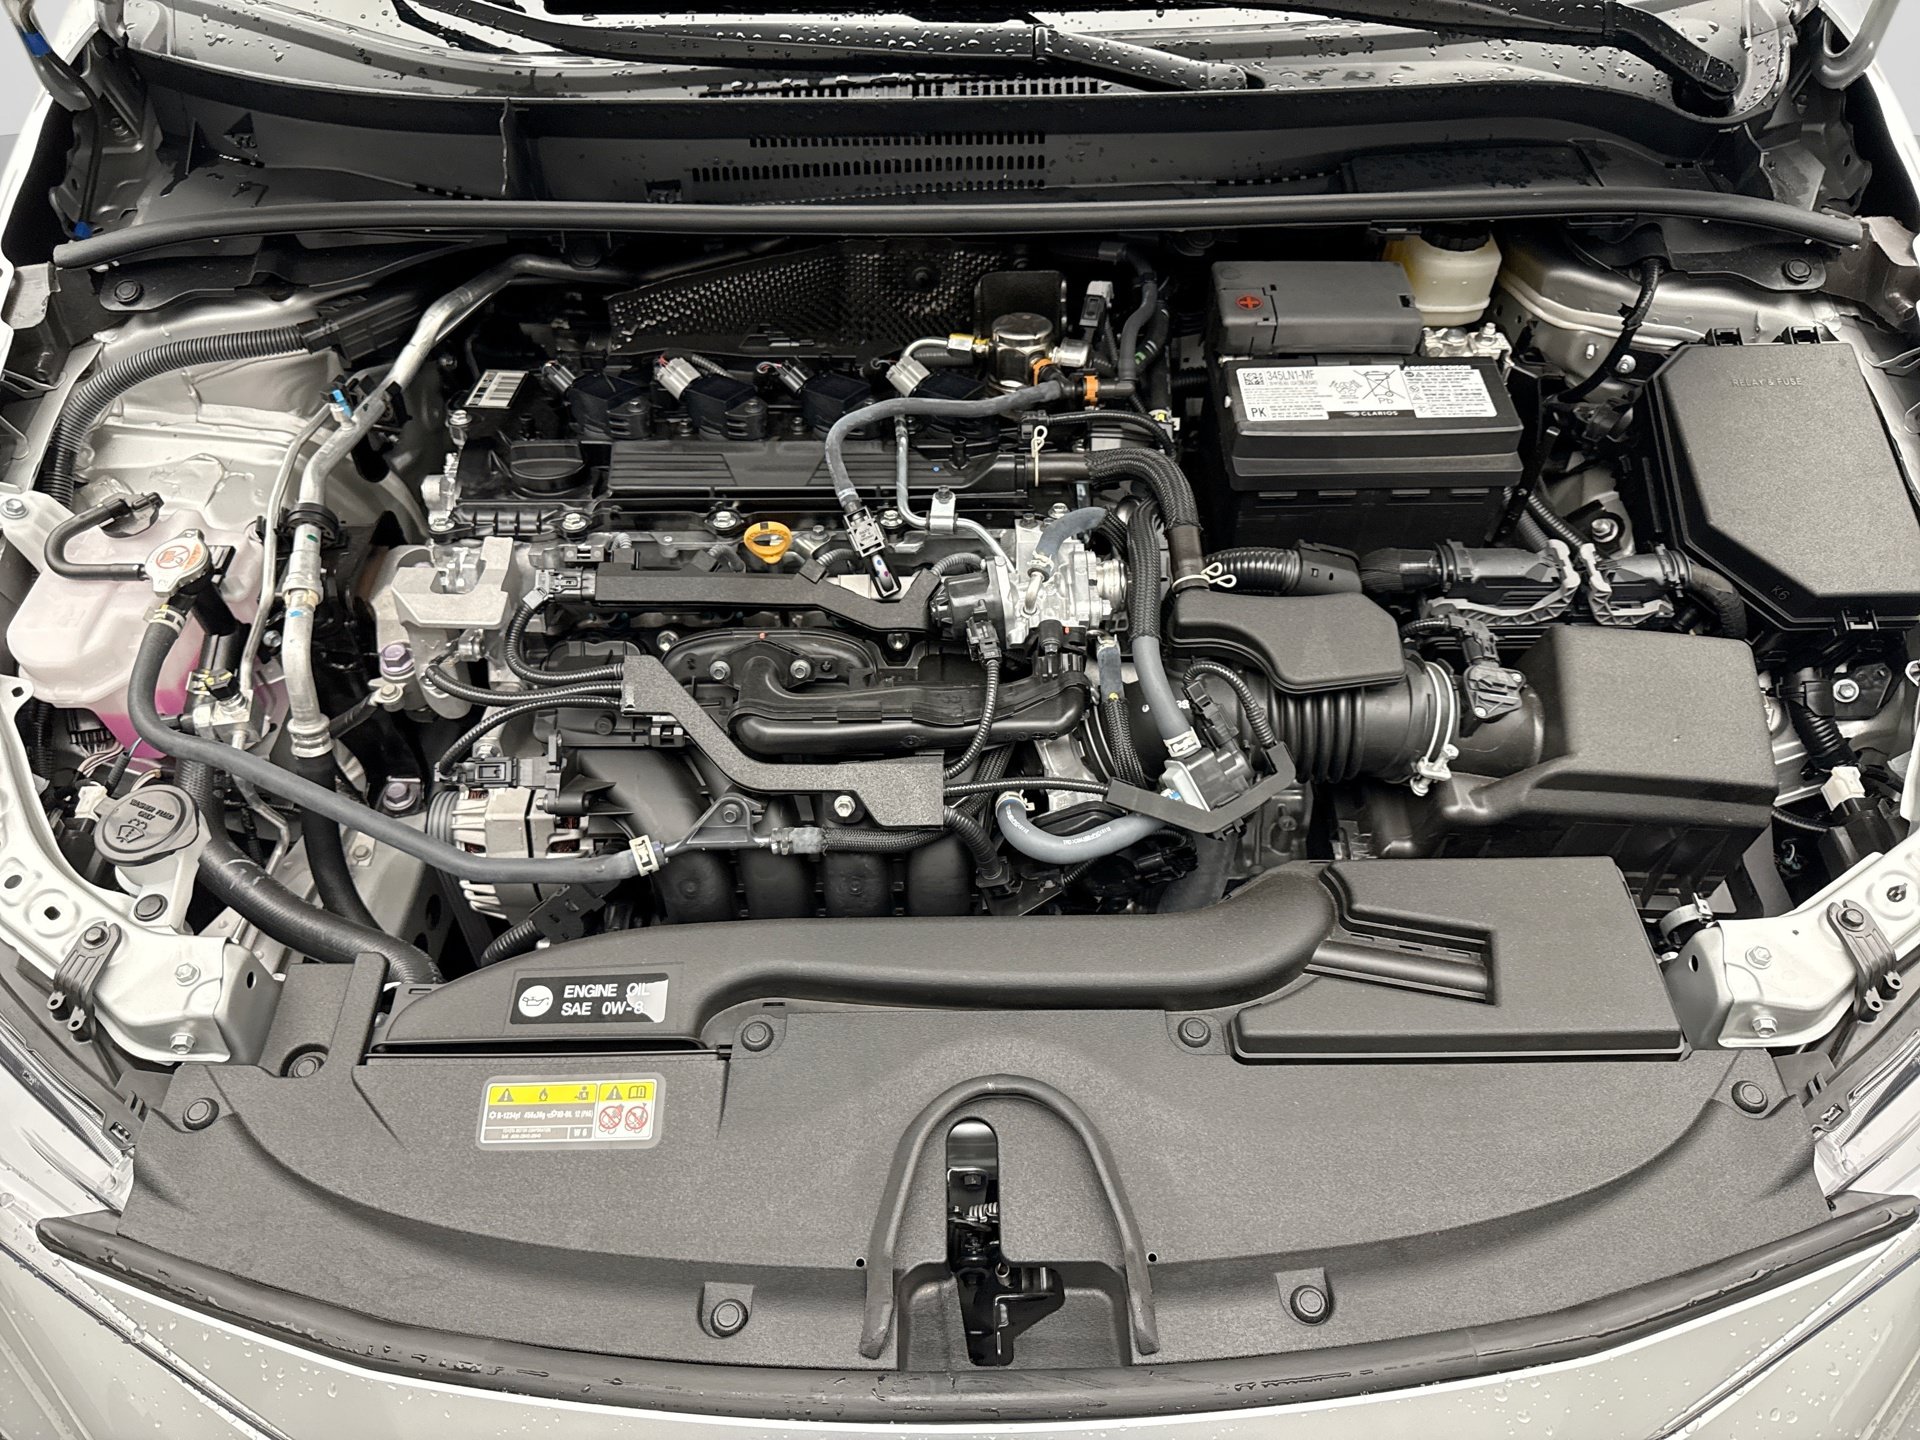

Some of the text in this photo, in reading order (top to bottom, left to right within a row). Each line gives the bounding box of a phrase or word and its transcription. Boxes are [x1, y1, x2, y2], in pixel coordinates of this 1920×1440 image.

[1731, 377, 1802, 387] RELAY & FUSE
[1250, 407, 1267, 417] PK
[1770, 585, 1790, 600] K6
[563, 982, 650, 998] ENGINE OIL
[560, 1002, 592, 1016] SAE
